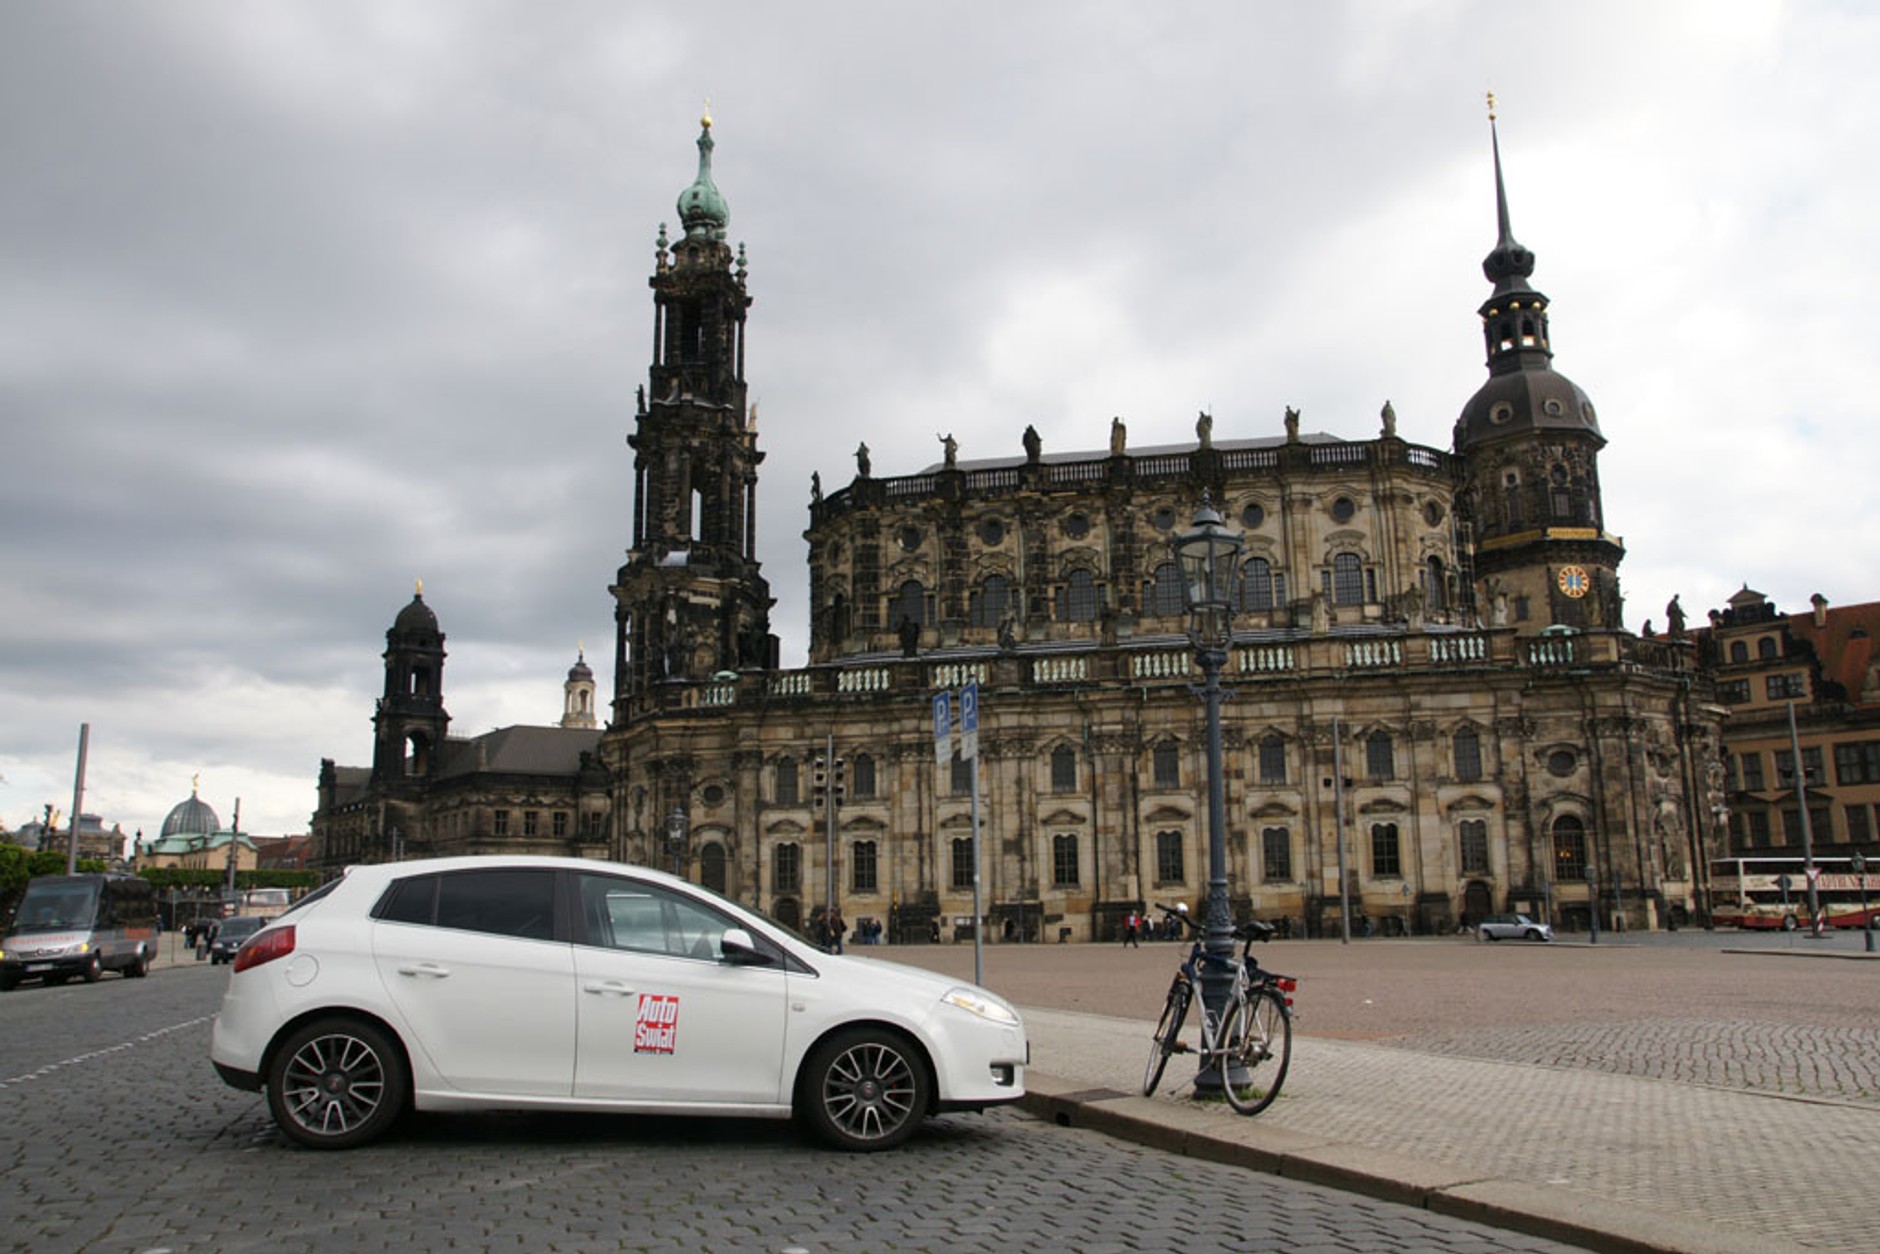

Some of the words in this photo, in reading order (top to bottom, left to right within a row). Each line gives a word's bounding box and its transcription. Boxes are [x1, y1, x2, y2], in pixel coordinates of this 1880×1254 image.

[936, 700, 946, 734] P
[963, 692, 973, 729] P
[637, 995, 677, 1024] Auto
